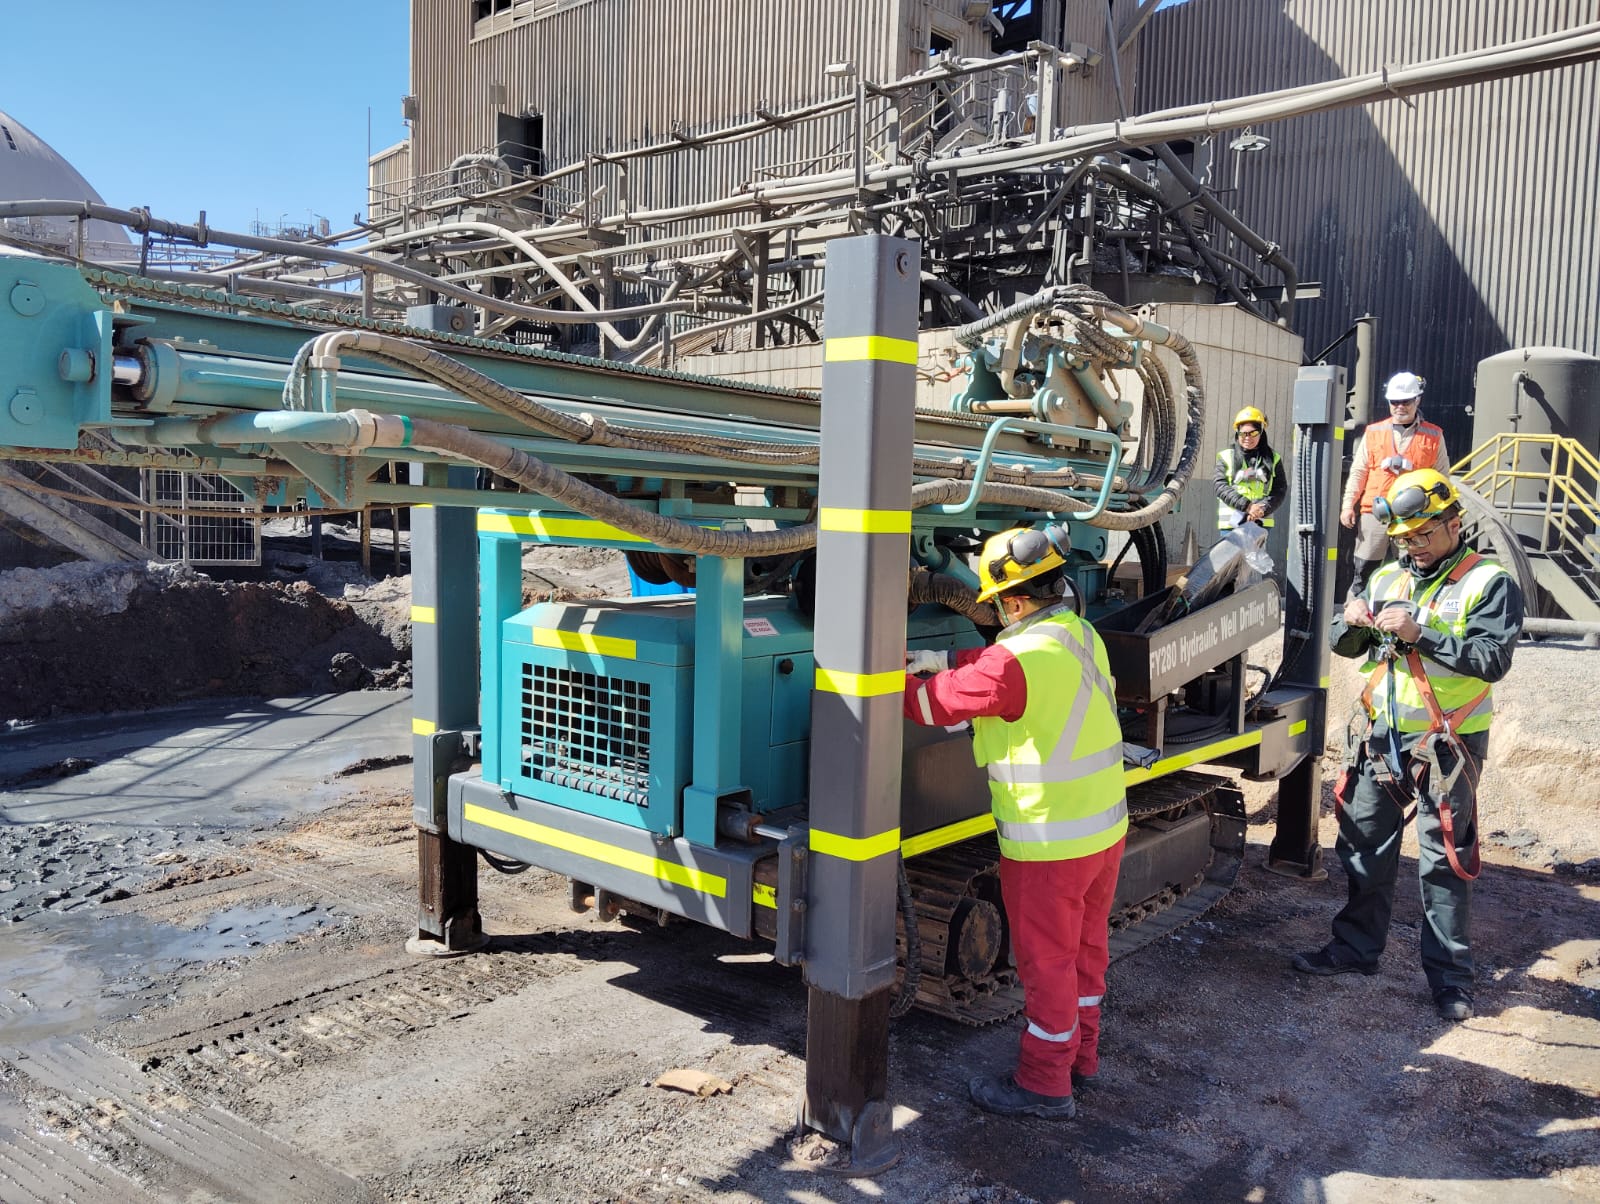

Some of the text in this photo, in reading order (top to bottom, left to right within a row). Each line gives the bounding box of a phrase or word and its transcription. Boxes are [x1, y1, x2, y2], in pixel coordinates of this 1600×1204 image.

[1149, 591, 1279, 680] FY280 Hydraulic Well Drilling Rig
